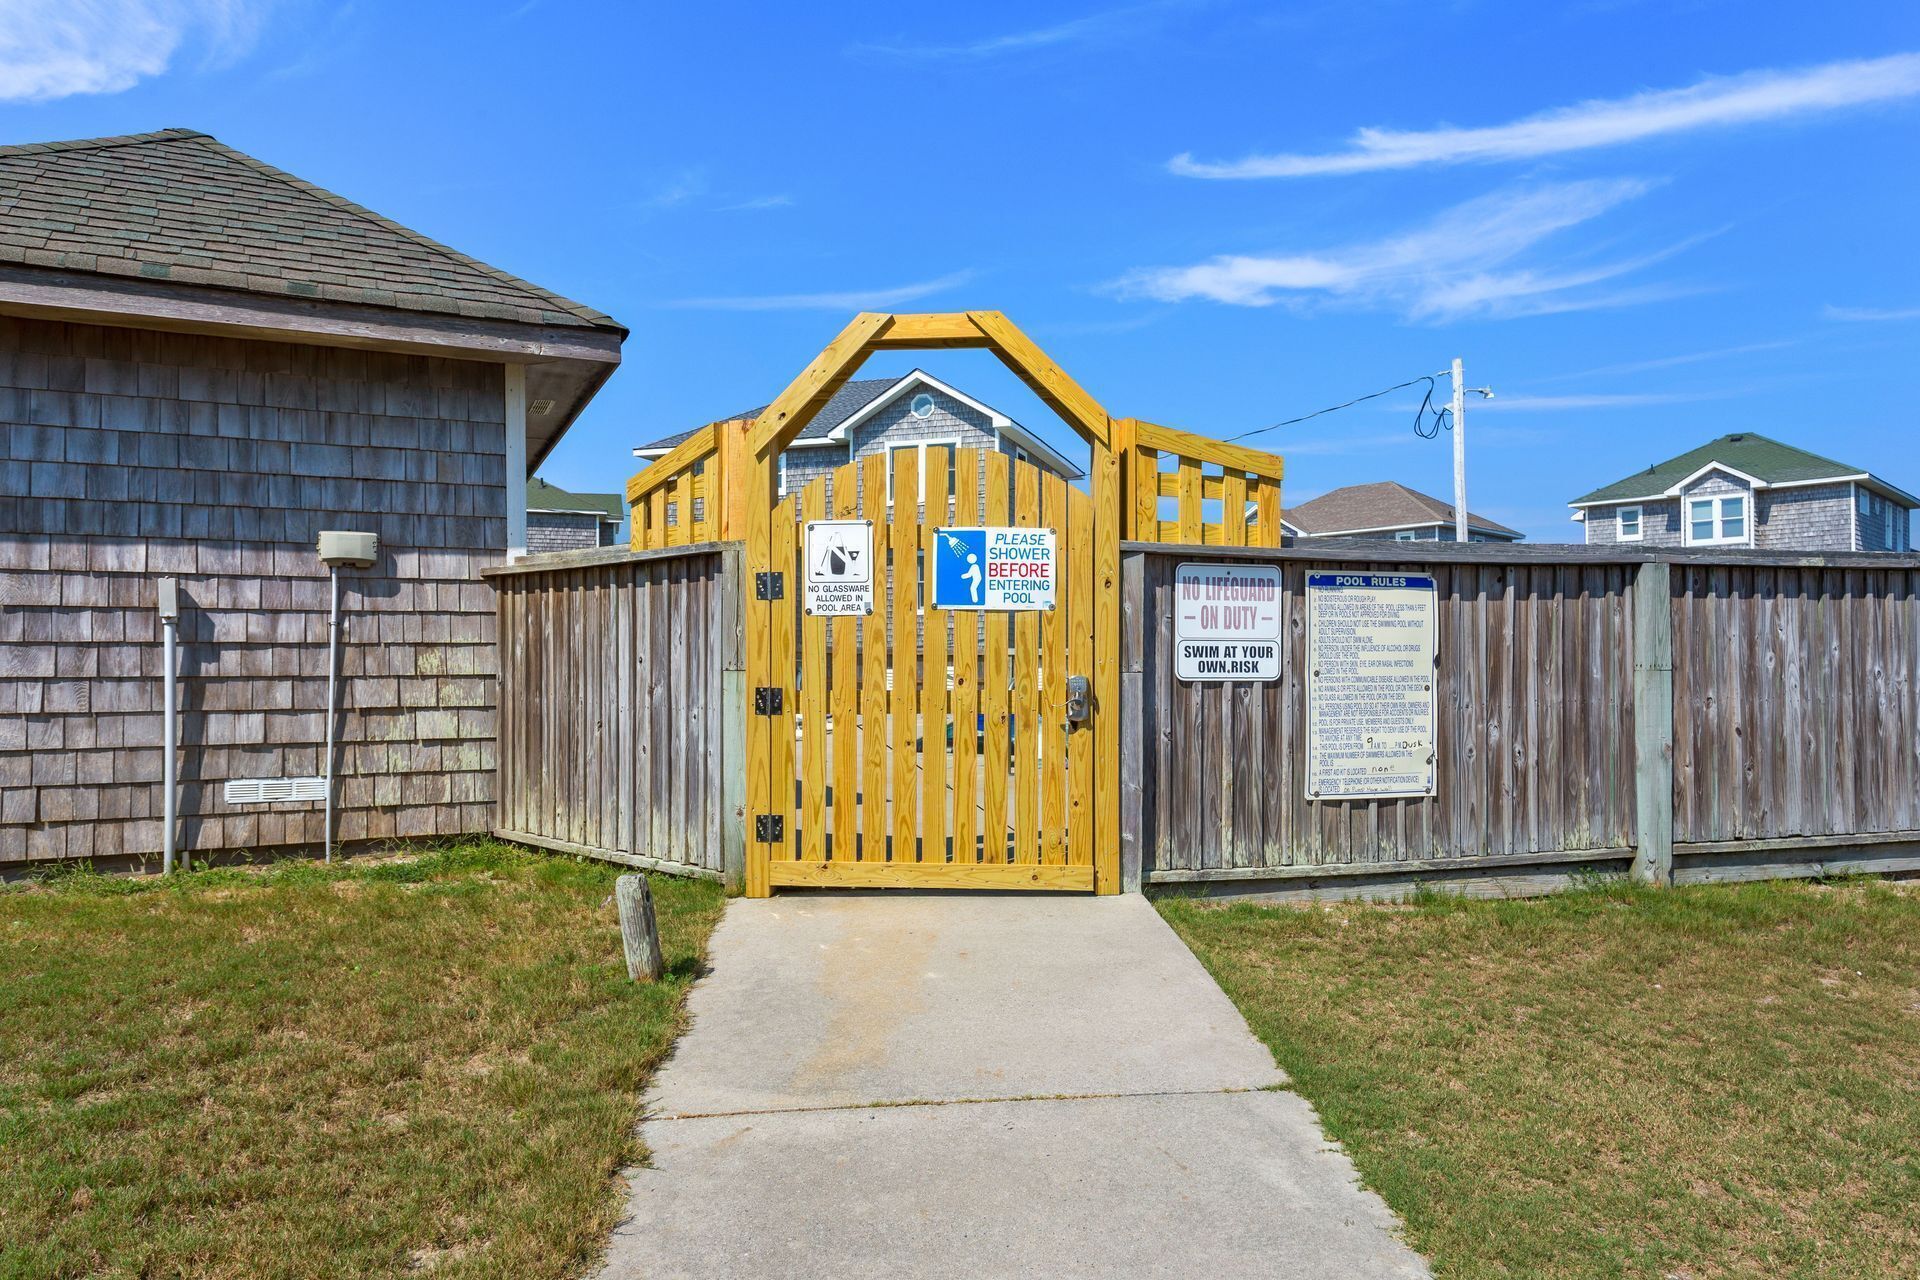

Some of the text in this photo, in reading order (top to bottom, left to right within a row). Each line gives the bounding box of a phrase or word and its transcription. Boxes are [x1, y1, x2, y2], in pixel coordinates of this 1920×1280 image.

[995, 534, 1046, 545] PLEASE
[989, 548, 1050, 560] SHOWER
[988, 563, 1050, 578] BEFORE
[988, 580, 1050, 590] ENTERING
[1336, 577, 1407, 587] POOL RULES
[1182, 576, 1275, 602] NO LIFEGUARD
[1004, 592, 1035, 604] POOL
[1200, 605, 1258, 630] ON DUTY
[1184, 646, 1273, 658] SWIM AT YOUR
[1198, 660, 1260, 673] OWN RISK
[1402, 740, 1422, 749] Dusk
